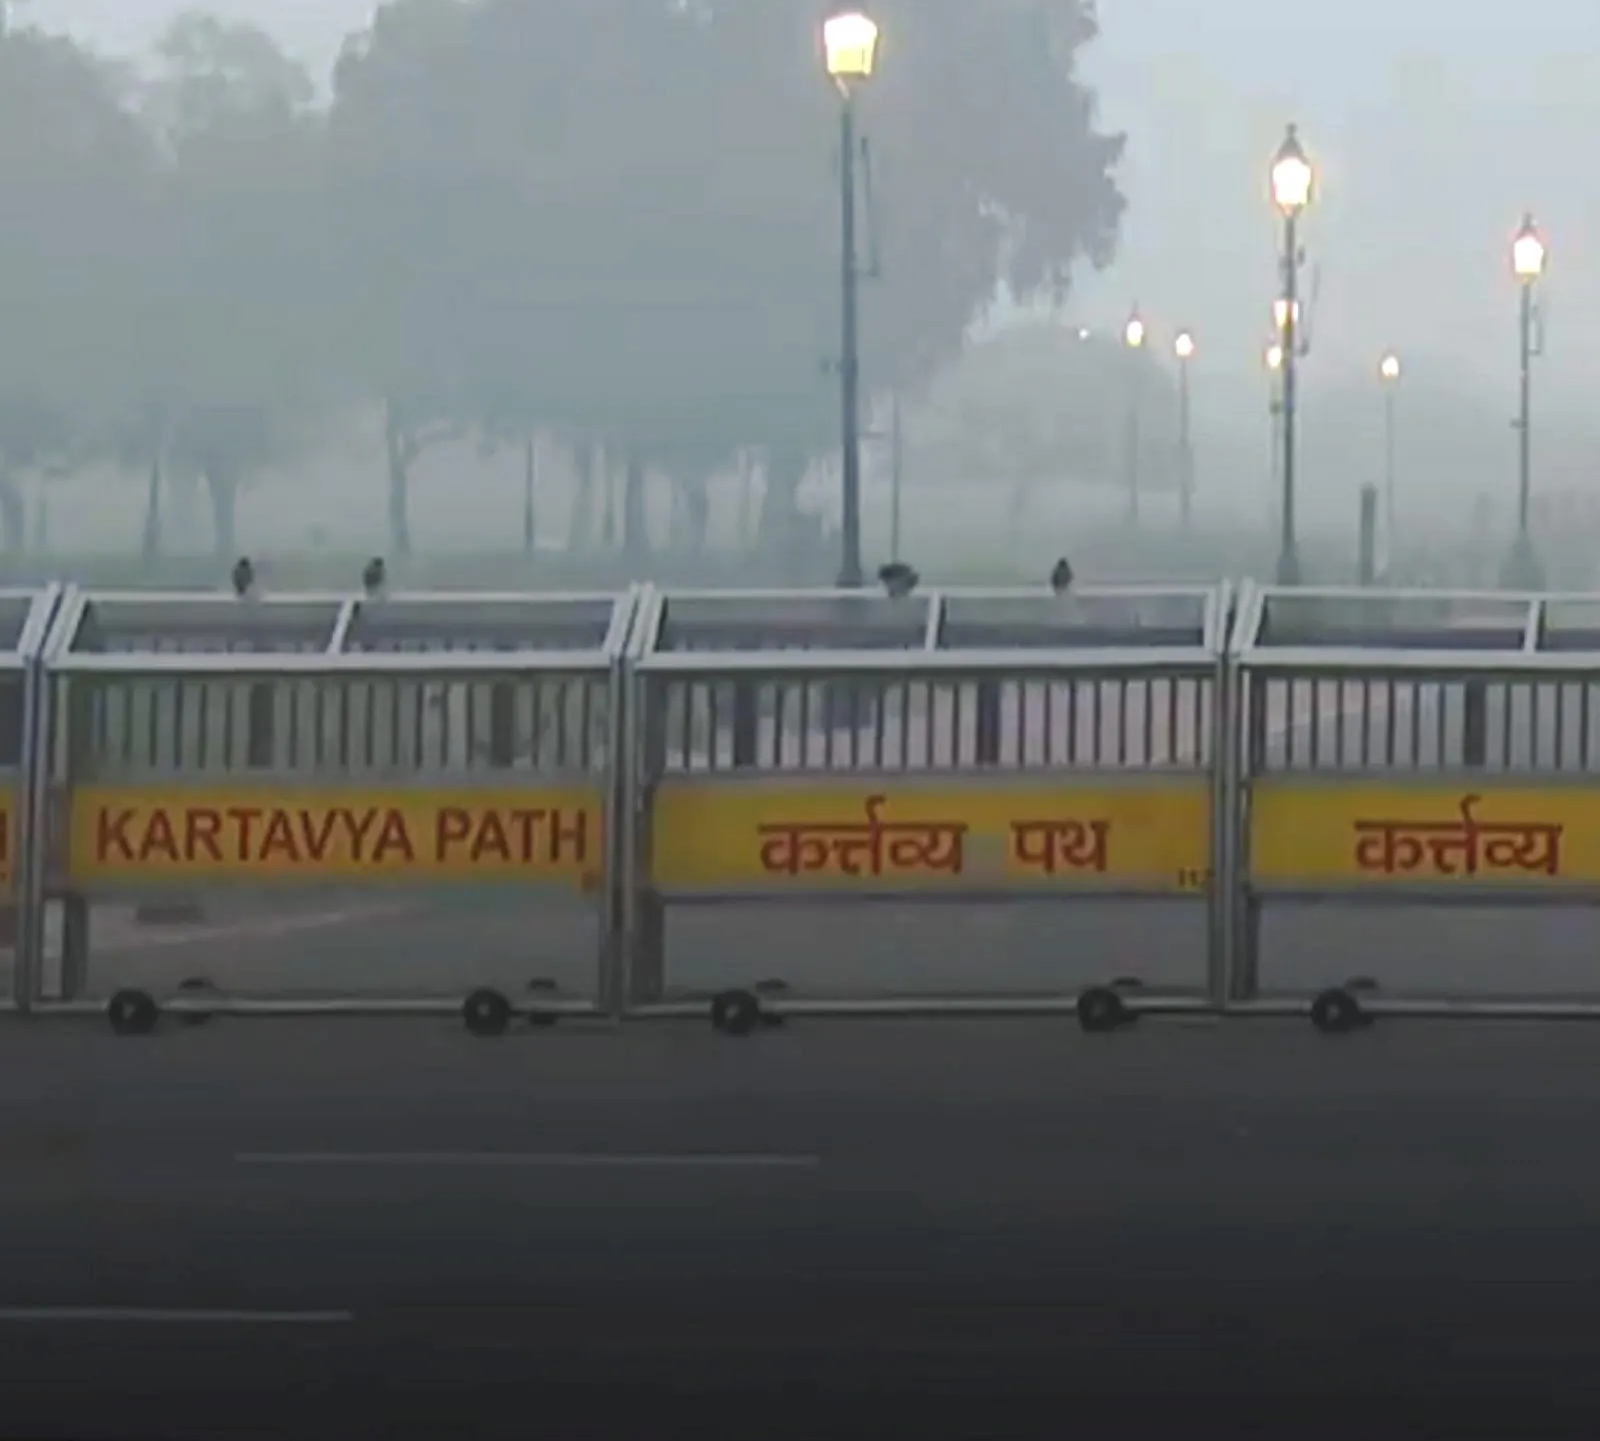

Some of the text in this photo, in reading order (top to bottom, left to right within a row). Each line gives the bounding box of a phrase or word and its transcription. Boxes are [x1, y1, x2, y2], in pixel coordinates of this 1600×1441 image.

[96, 808, 588, 864] KARTAVYA PATH
[758, 795, 1110, 877] कर्त्तव्य पथ
[1354, 795, 1563, 877] कर्त्तव्य
